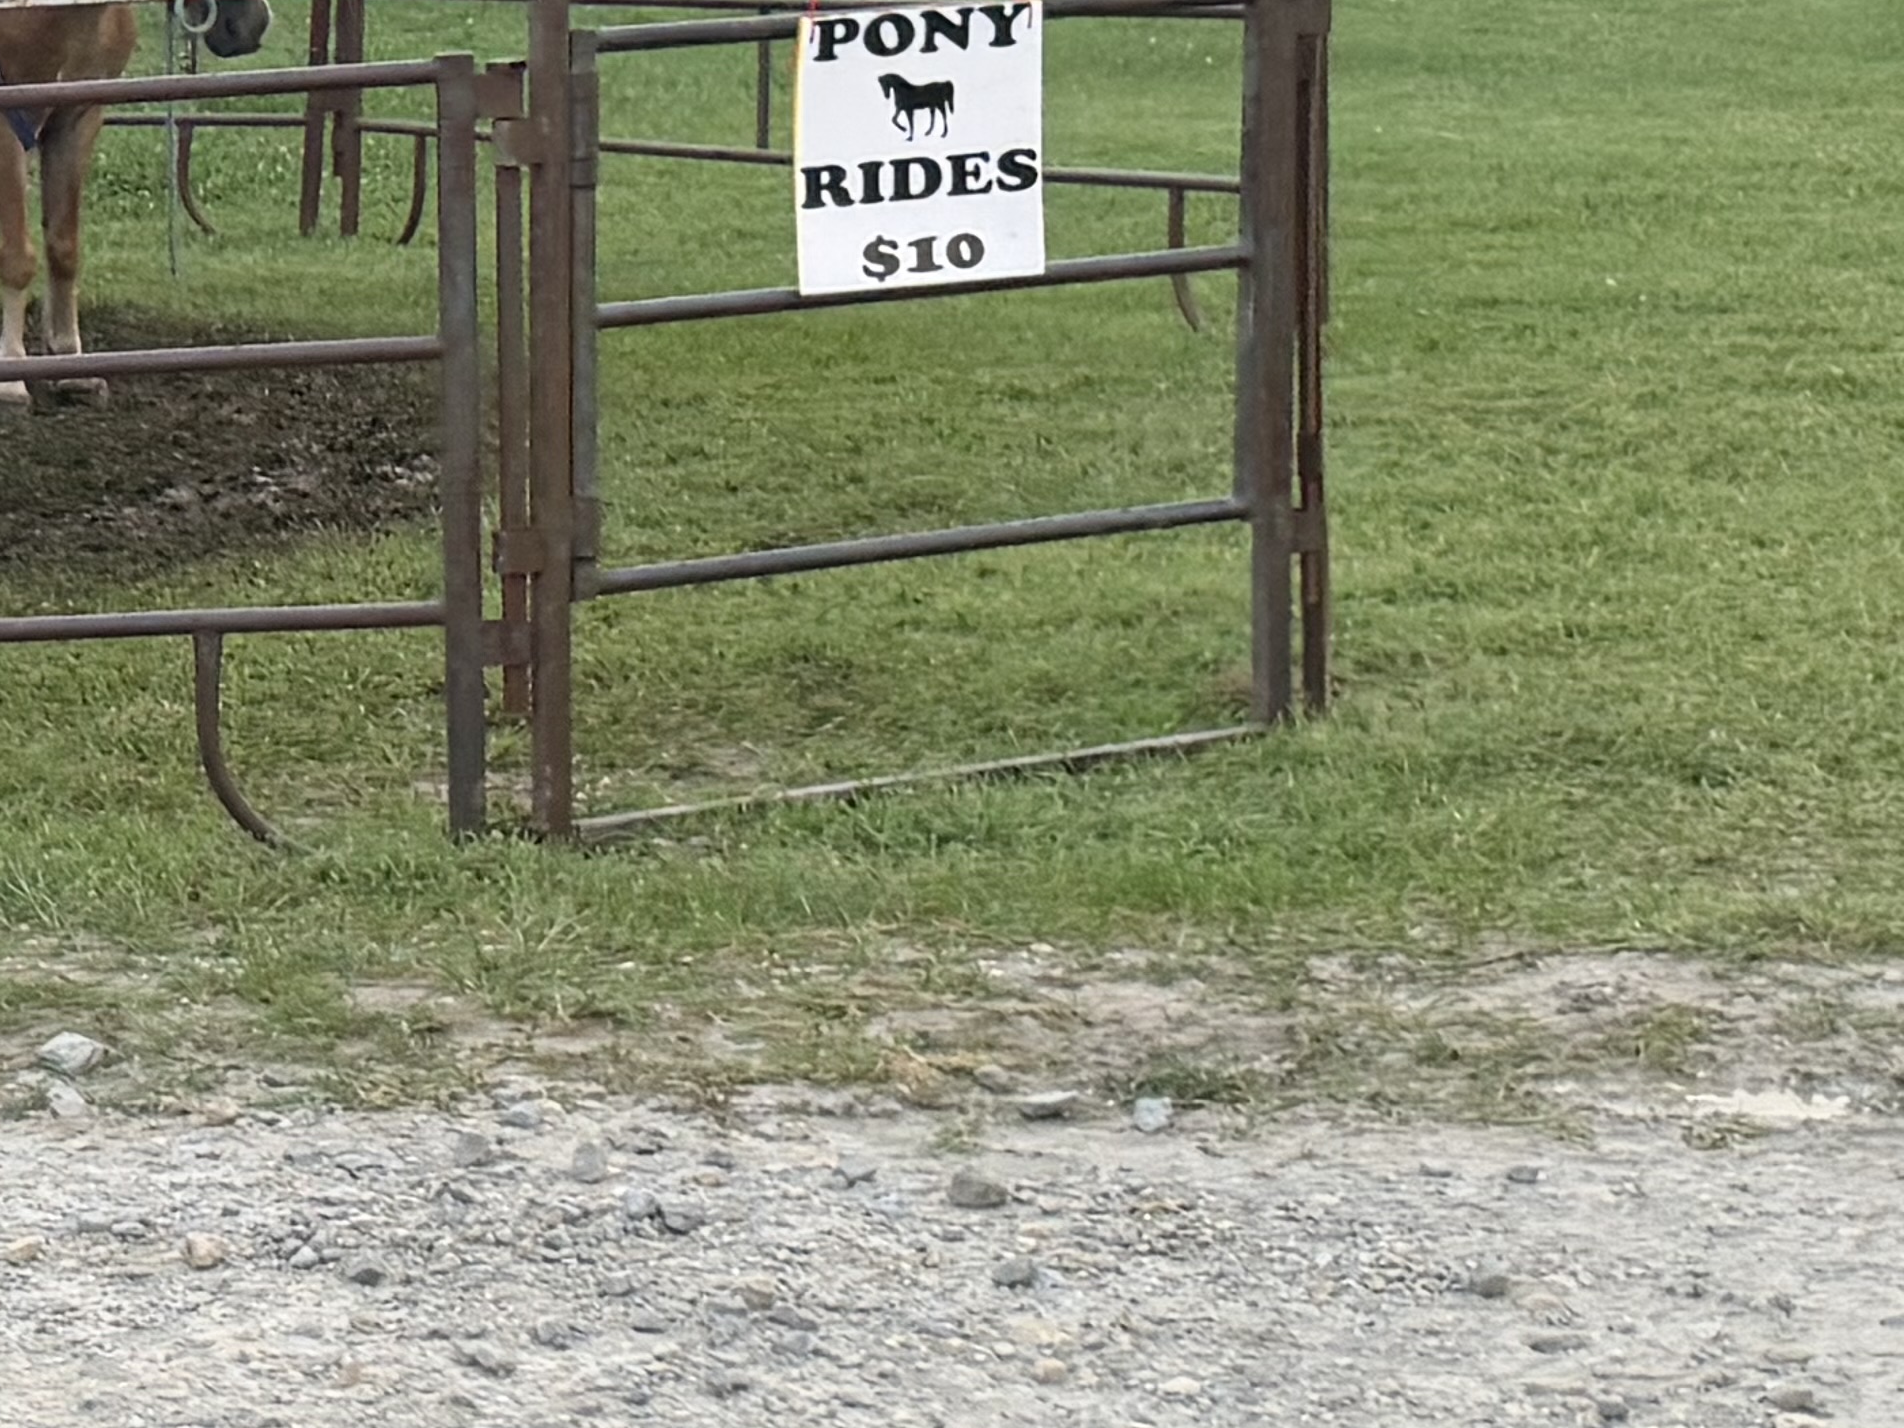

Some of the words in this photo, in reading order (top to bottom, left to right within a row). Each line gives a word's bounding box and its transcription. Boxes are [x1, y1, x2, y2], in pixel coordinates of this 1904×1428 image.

[813, 3, 1031, 62] PONY
[801, 149, 1038, 209] RIDES
[863, 233, 985, 282] $10
